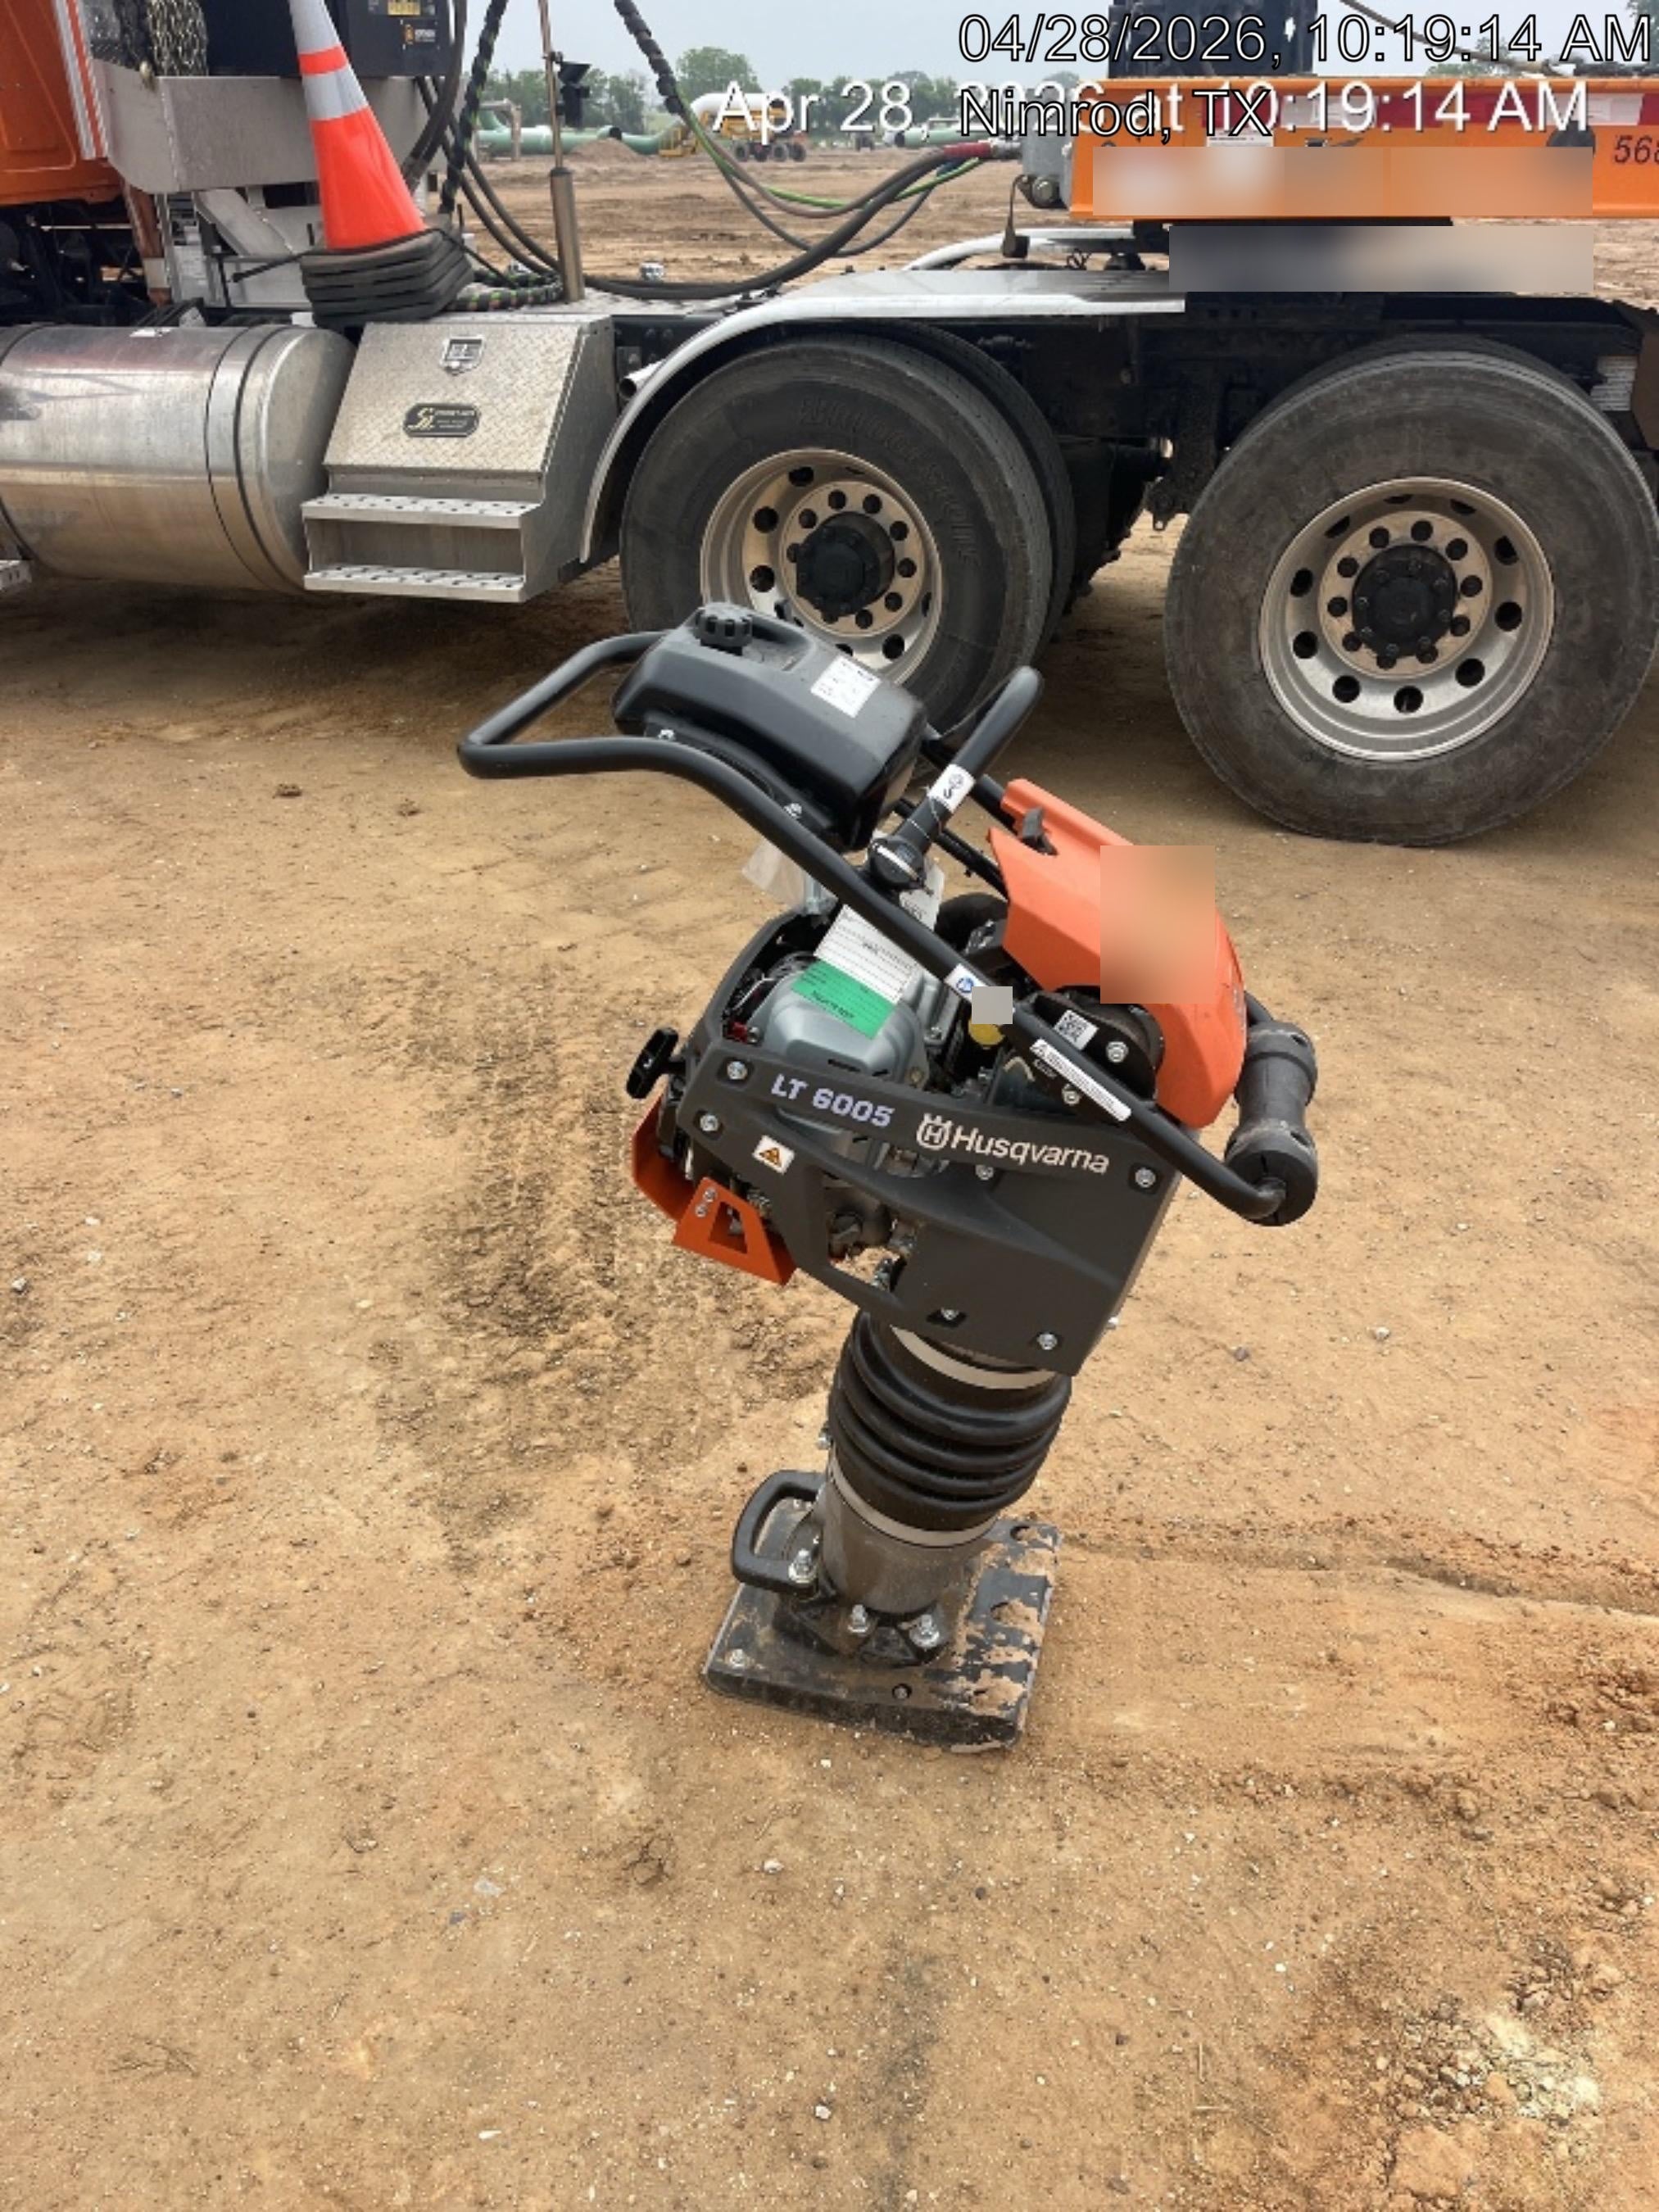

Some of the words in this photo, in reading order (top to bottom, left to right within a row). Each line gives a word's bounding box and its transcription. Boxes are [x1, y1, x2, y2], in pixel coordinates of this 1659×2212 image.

[771, 1073, 809, 1100] LT
[812, 1088, 895, 1127] 6005
[950, 1124, 1109, 1175] Husqvarna
